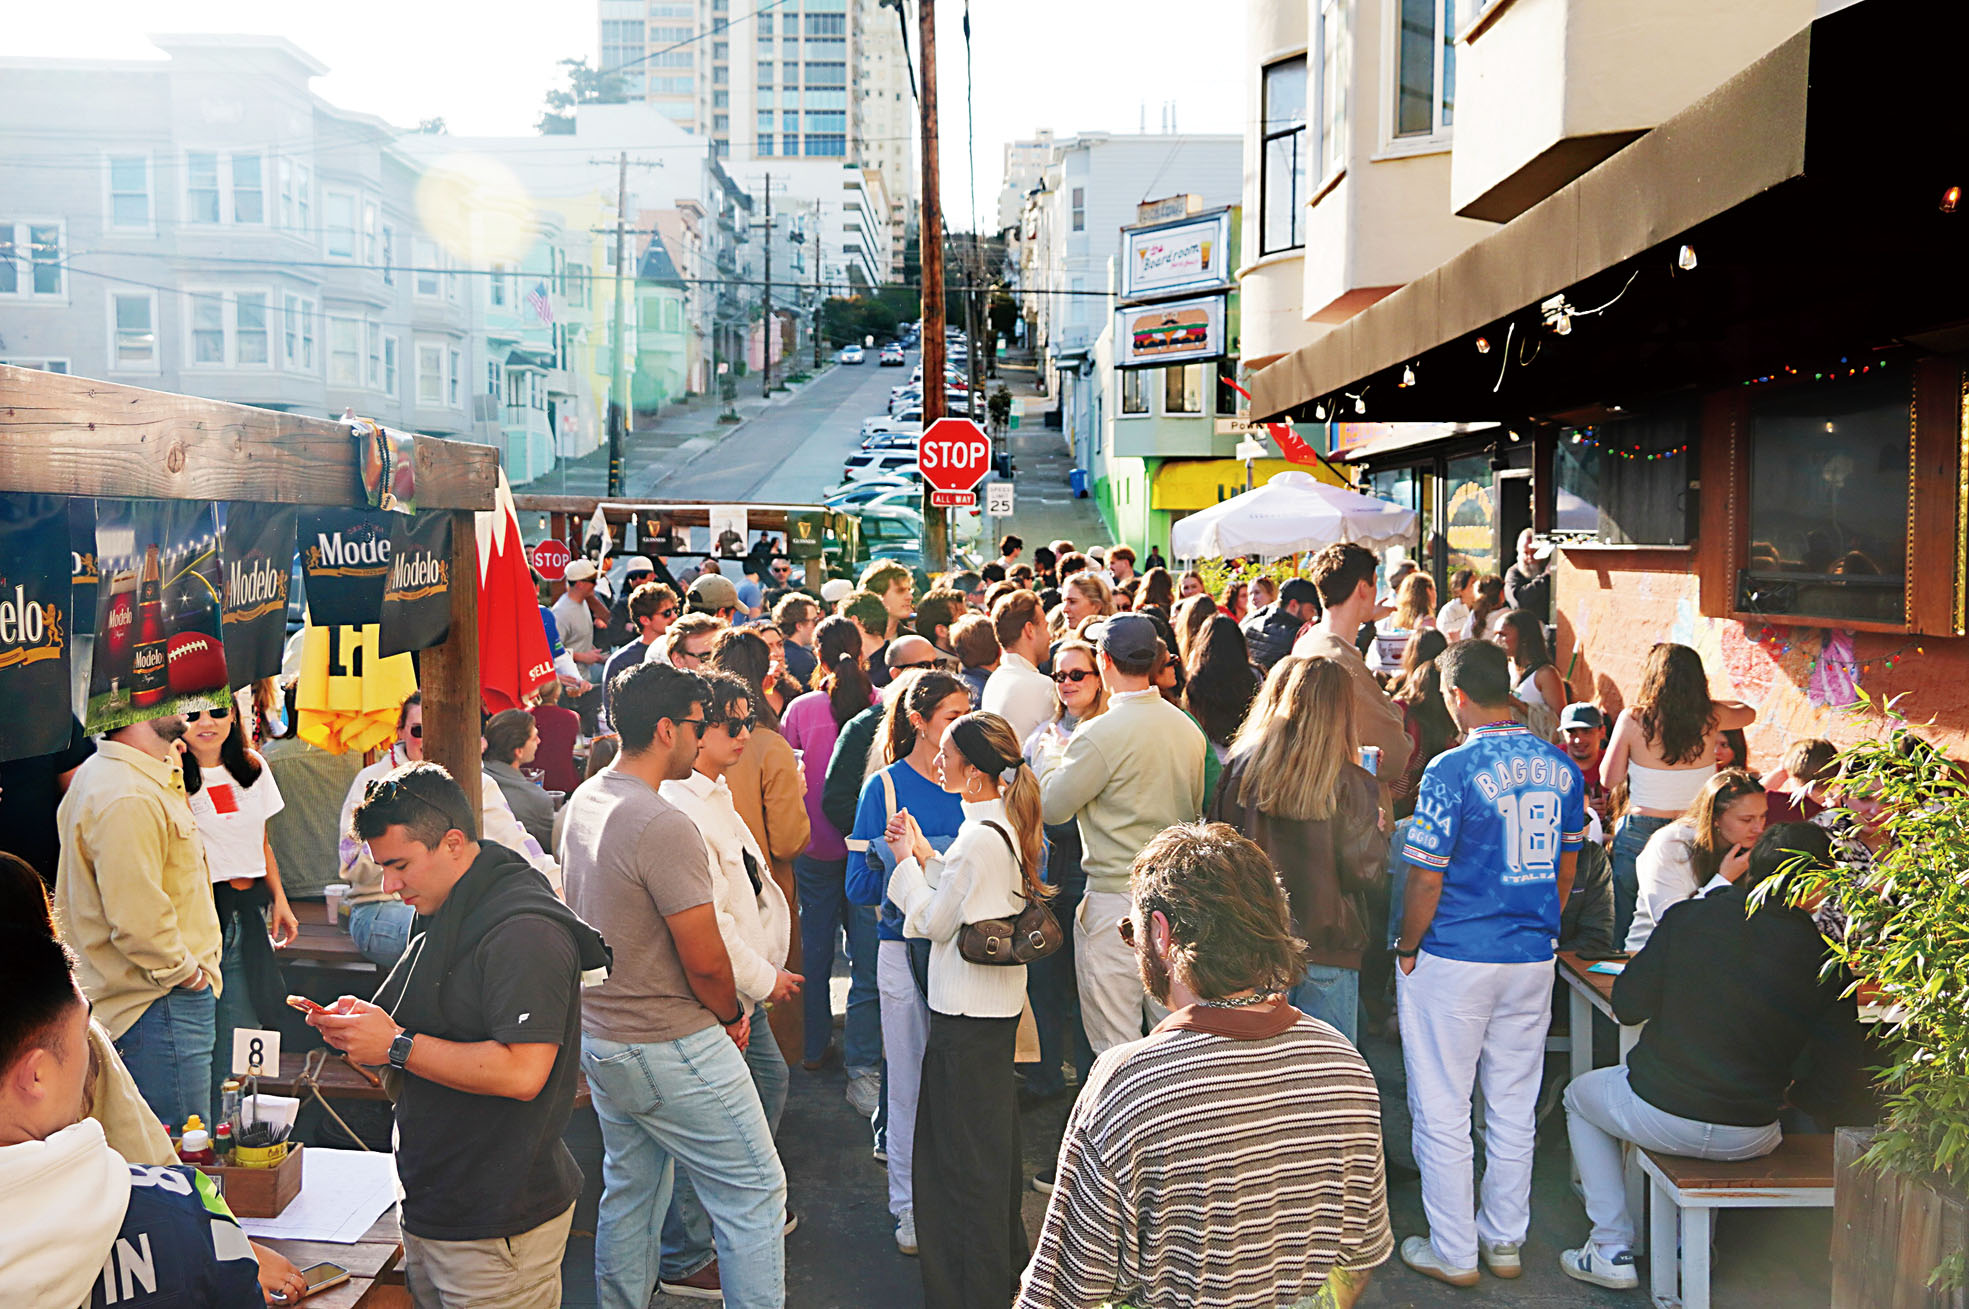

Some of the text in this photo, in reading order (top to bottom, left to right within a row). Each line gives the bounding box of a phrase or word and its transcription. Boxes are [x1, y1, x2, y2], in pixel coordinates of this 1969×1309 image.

[923, 441, 985, 469] STOP
[935, 494, 972, 504] ALL WAY
[990, 500, 1010, 512] 25
[318, 531, 391, 566] Mode
[534, 552, 570, 567] STOP
[229, 556, 278, 608] Modelo
[392, 550, 440, 589] Modelo
[108, 606, 133, 629] Modelo
[135, 648, 163, 669] Modelo
[1474, 756, 1573, 801] BAGGIO
[1417, 794, 1452, 838] ALIA
[1407, 828, 1438, 850] GGIO
[1497, 791, 1563, 873] 18
[1503, 872, 1556, 883] ITALIA
[248, 1037, 264, 1068] 8
[103, 1232, 158, 1306] IN
